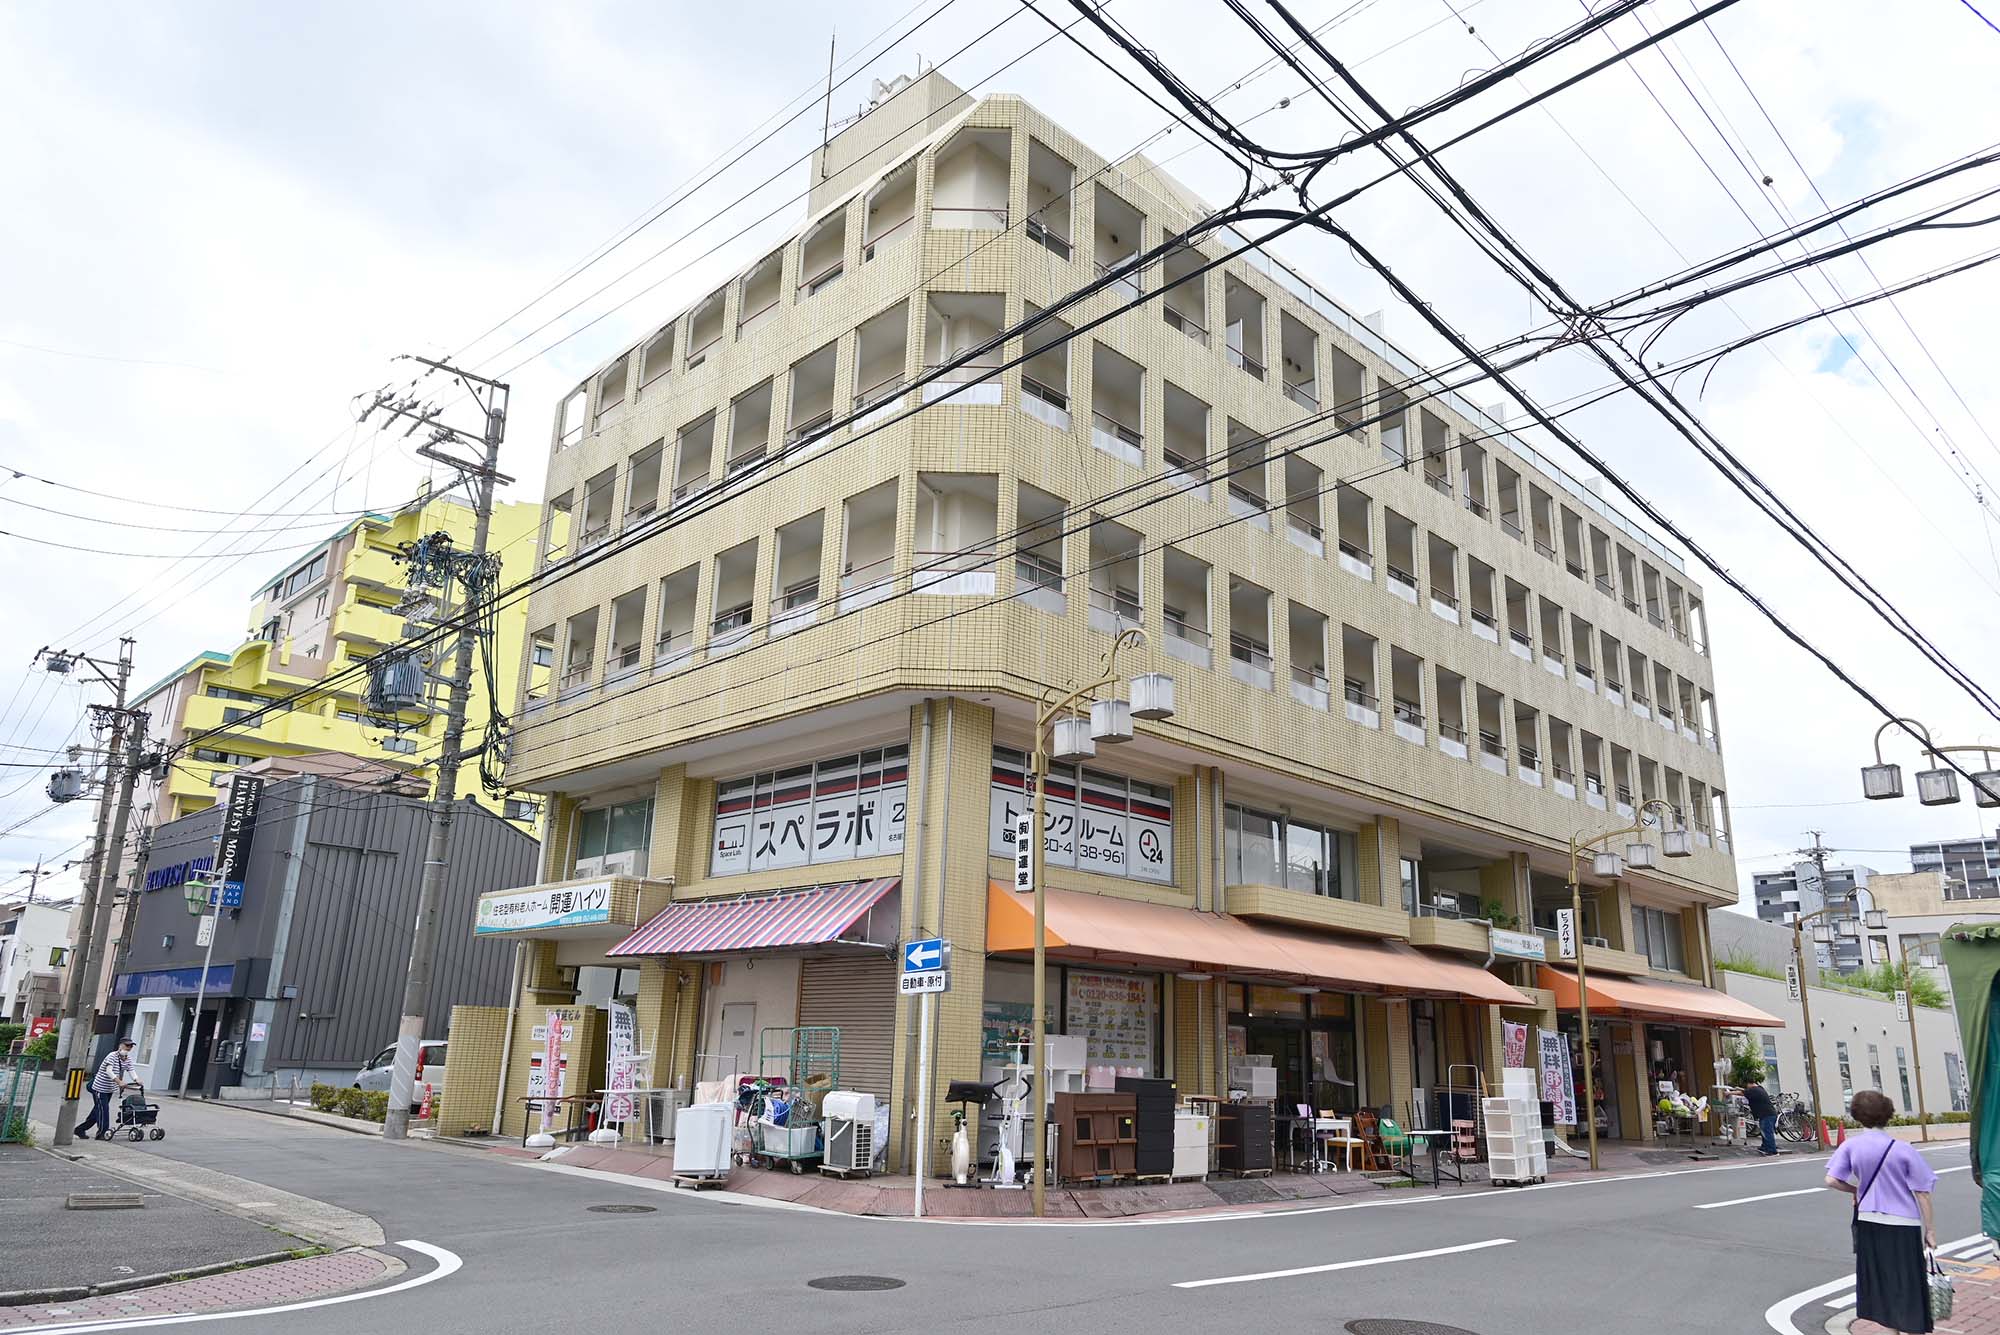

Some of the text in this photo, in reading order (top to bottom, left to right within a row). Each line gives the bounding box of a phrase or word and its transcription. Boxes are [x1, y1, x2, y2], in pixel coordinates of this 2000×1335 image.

[230, 780, 249, 835] HARVEST
[1005, 801, 1124, 847] トンクルーム
[756, 801, 875, 858] スペラボ
[1043, 838, 1125, 865] 20-438-961
[1149, 848, 1164, 864] 24
[549, 888, 607, 914] 開運ハイツ
